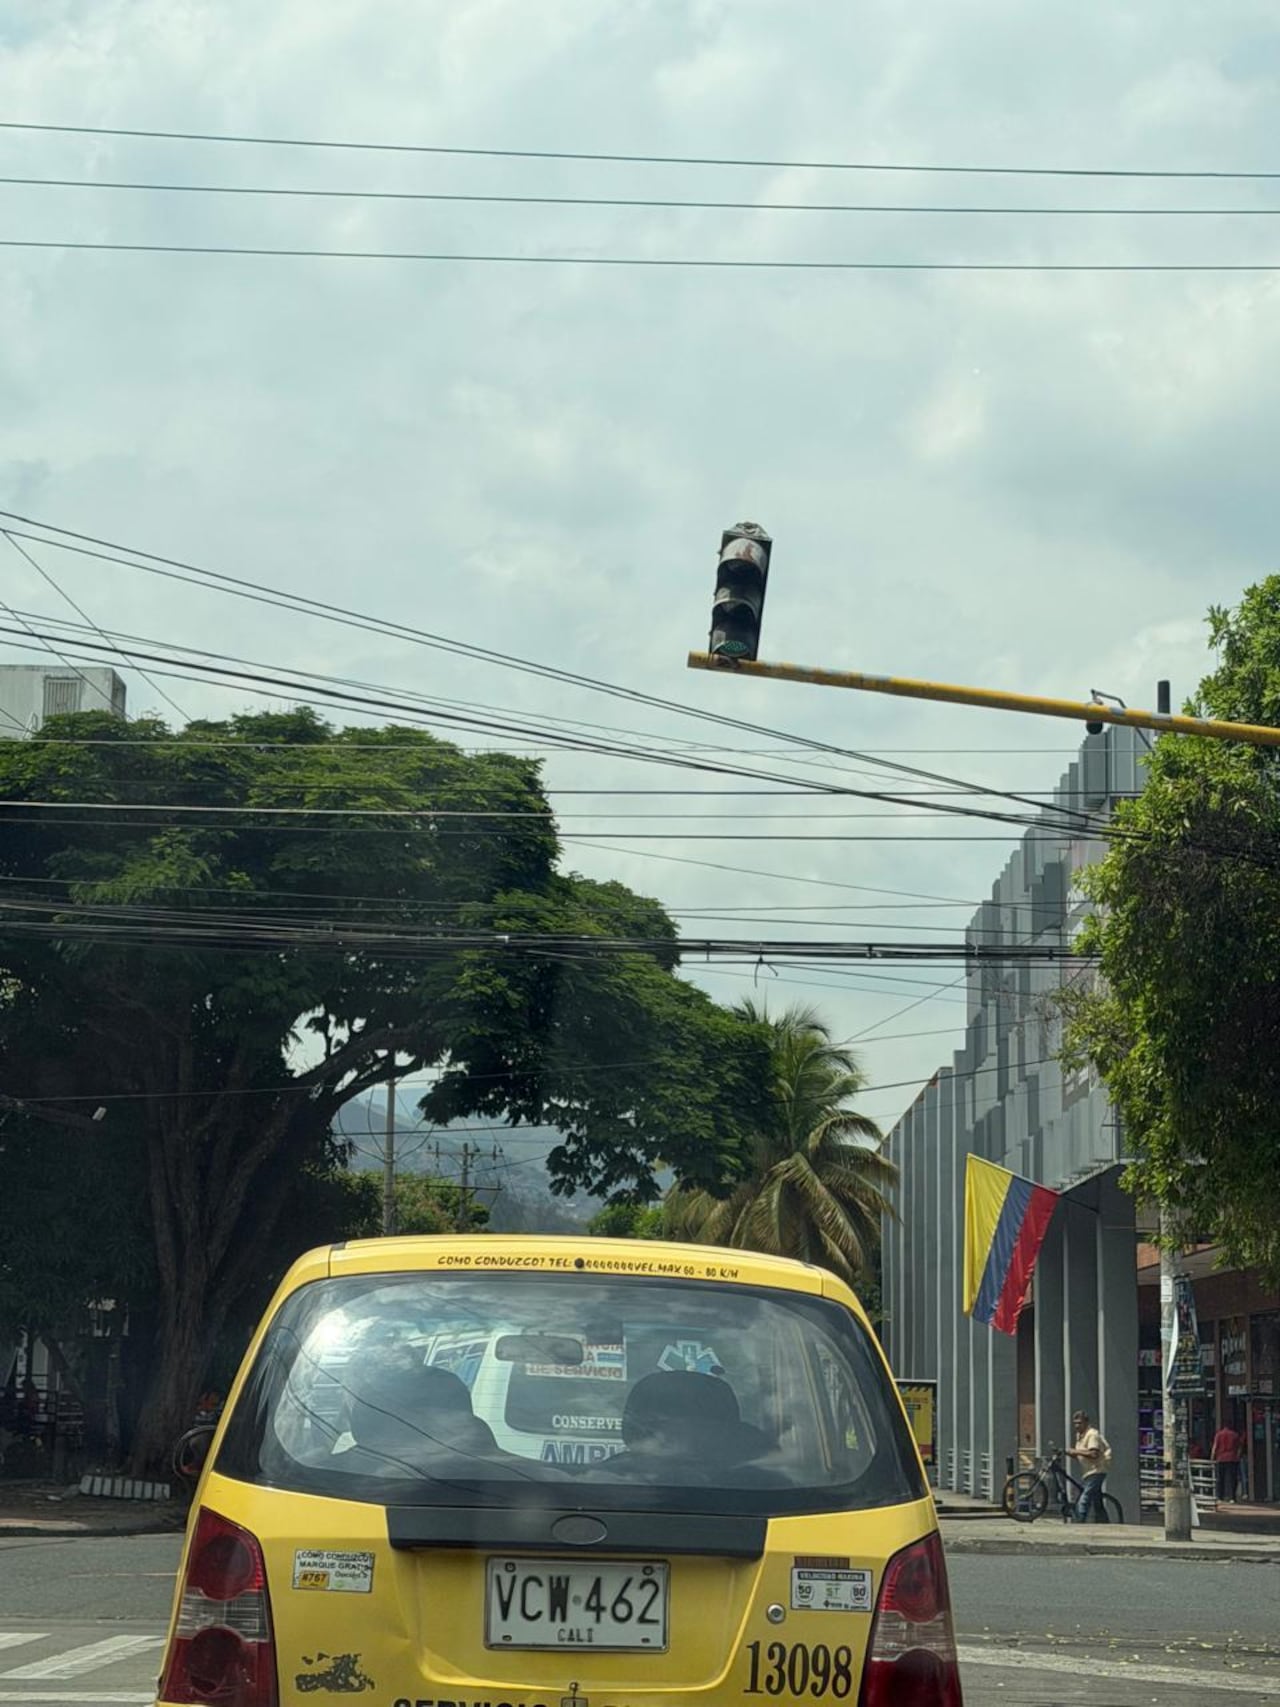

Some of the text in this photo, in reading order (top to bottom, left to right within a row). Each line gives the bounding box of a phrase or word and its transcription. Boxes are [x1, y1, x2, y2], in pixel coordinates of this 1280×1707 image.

[438, 1255, 472, 1265] COMO
[474, 1256, 545, 1266] CONDUZCO?
[552, 1414, 623, 1431] CONSERVE
[798, 1585, 812, 1595] 50
[557, 1628, 595, 1643] CALI
[743, 1640, 852, 1699] 13098
